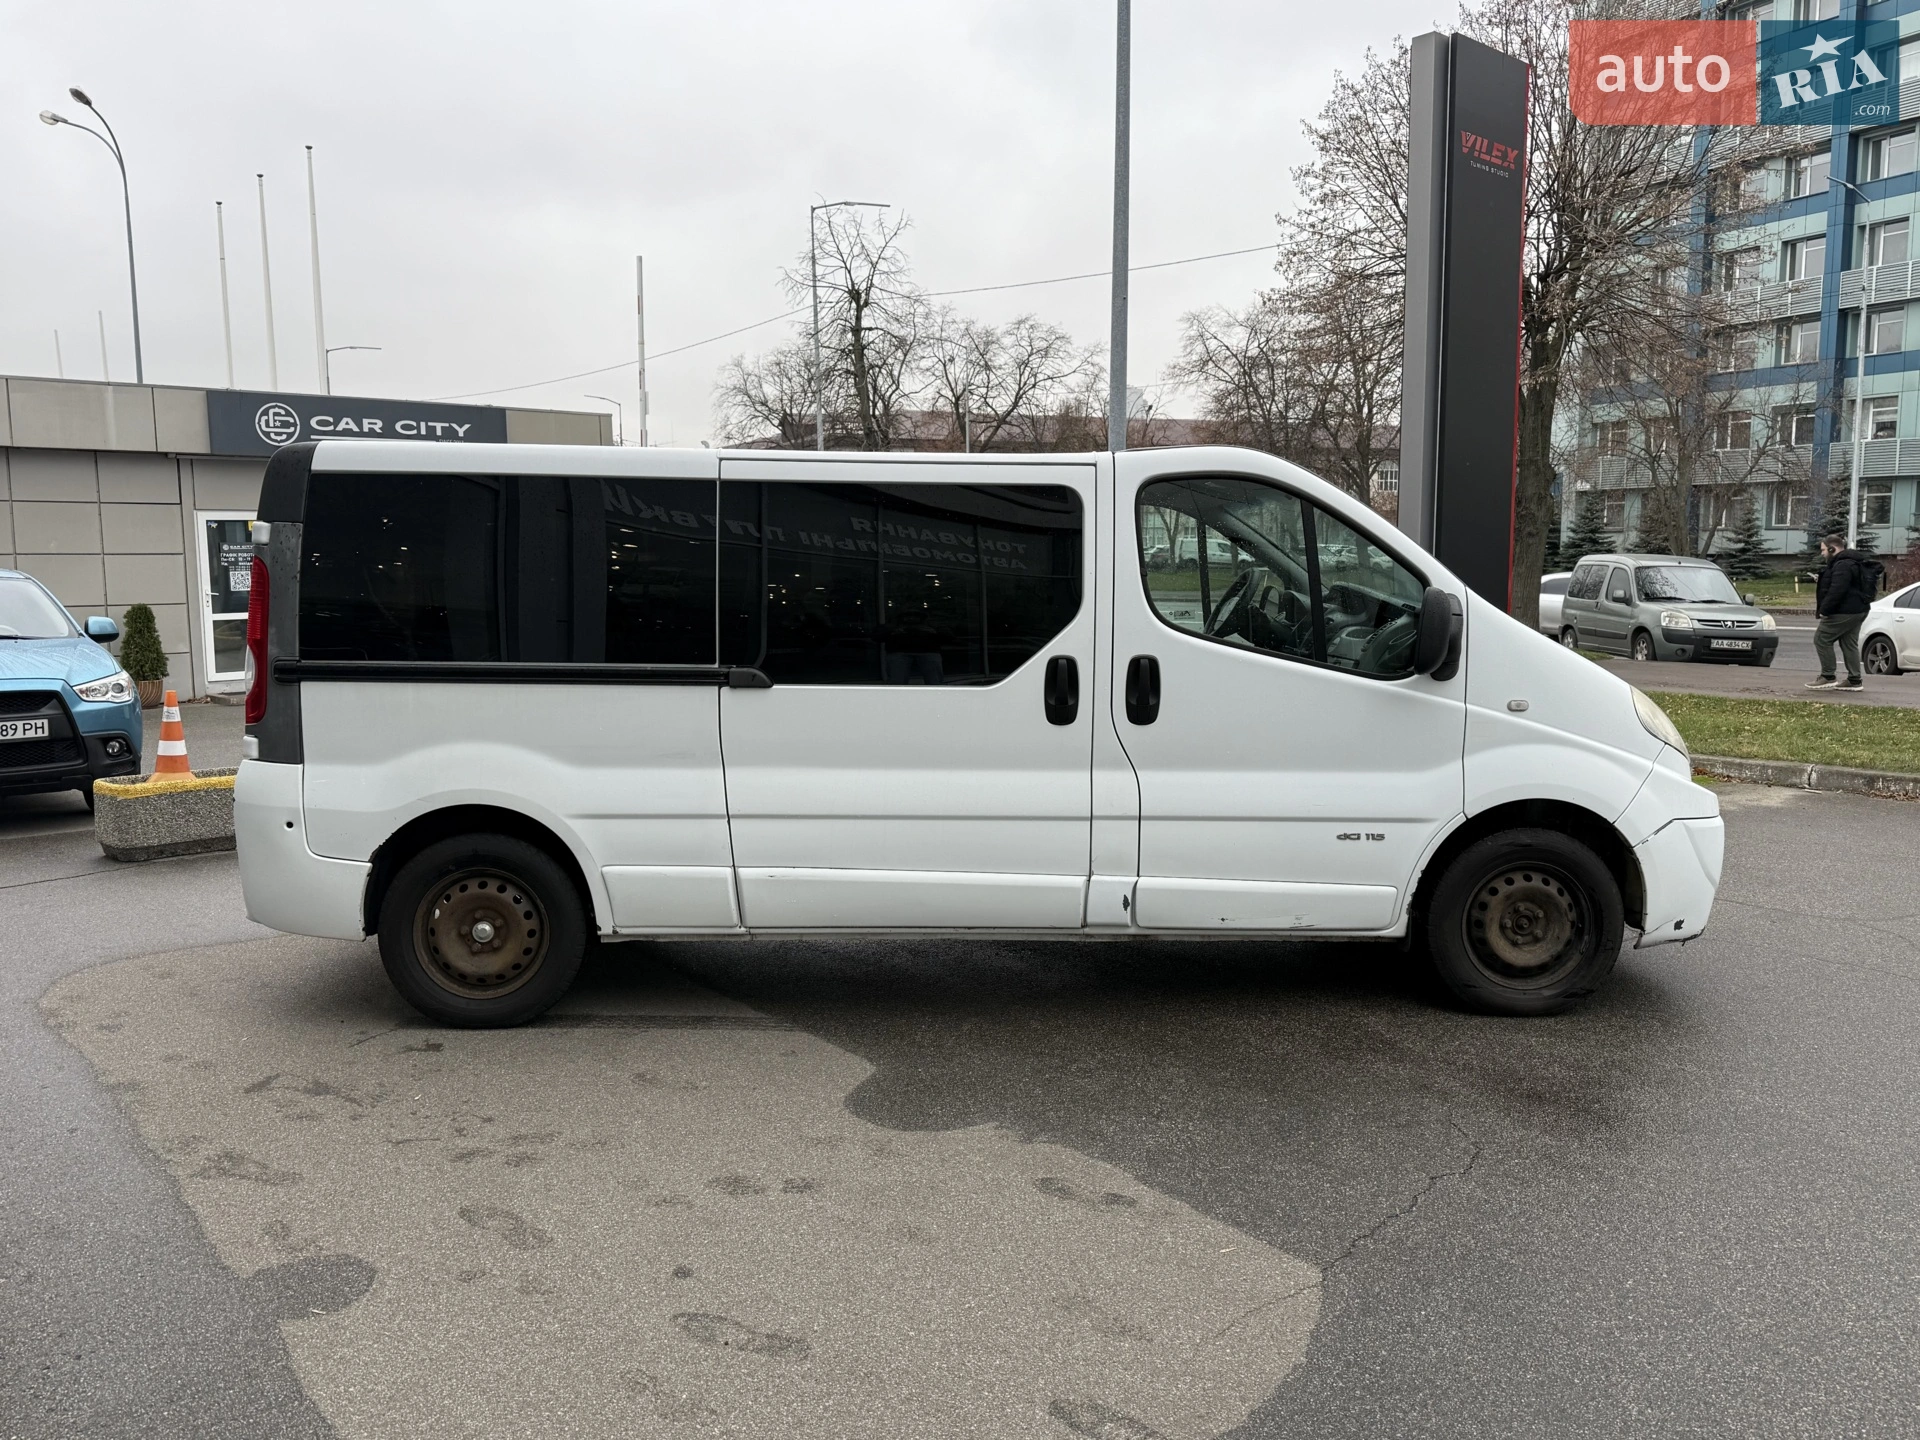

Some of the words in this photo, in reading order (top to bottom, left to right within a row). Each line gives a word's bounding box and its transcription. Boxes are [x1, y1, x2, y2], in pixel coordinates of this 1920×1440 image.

[1460, 130, 1519, 170] VILEX
[1490, 167, 1509, 178] STUDIO
[309, 415, 384, 433] CAR
[394, 420, 472, 437] CITY
[1715, 640, 1725, 648] AA
[1740, 641, 1750, 649] CX
[22, 721, 45, 736] PH
[1364, 832, 1386, 841] 115
